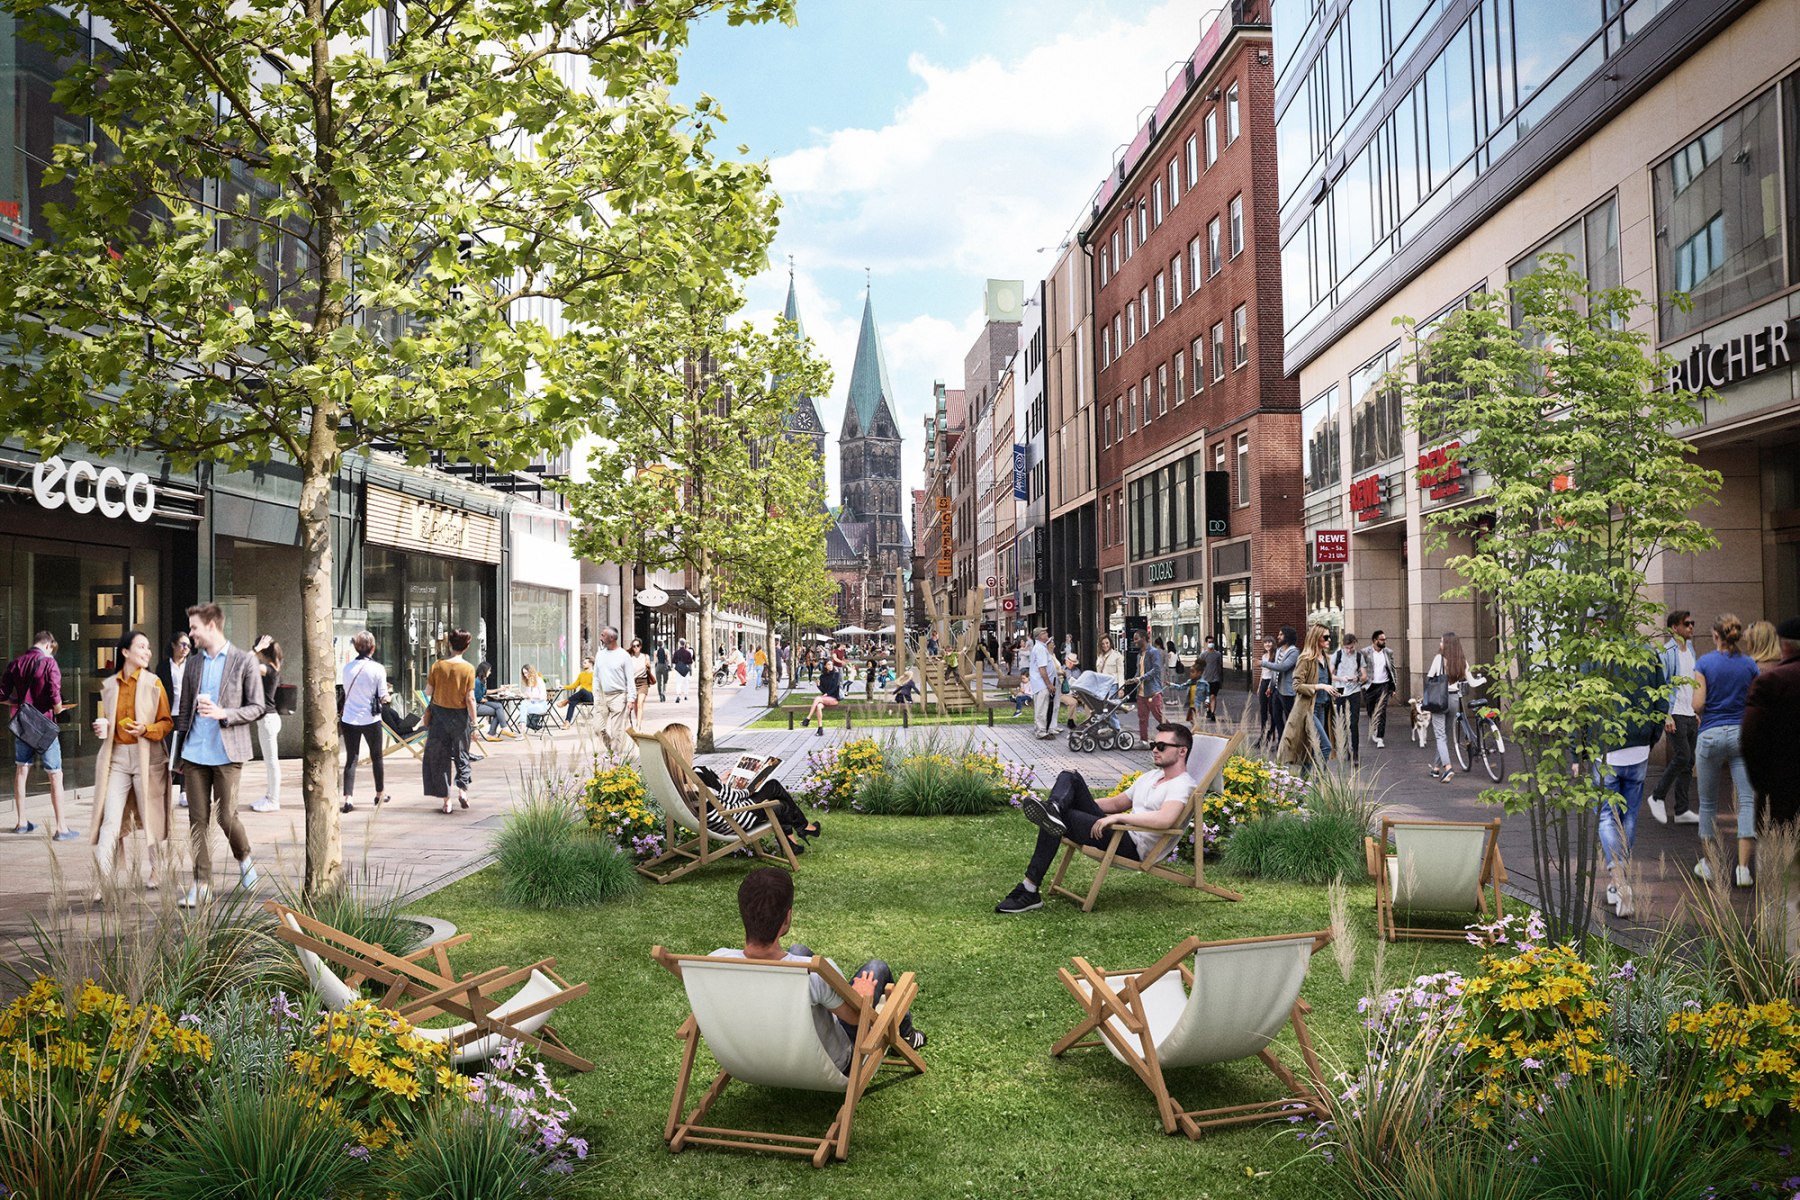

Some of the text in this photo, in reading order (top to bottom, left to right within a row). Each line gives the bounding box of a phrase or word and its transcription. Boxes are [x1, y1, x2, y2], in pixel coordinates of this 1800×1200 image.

[1669, 320, 1790, 395] BÜCHER
[33, 455, 155, 523] ecco
[1350, 474, 1380, 512] REWE
[1318, 534, 1346, 543] REWE
